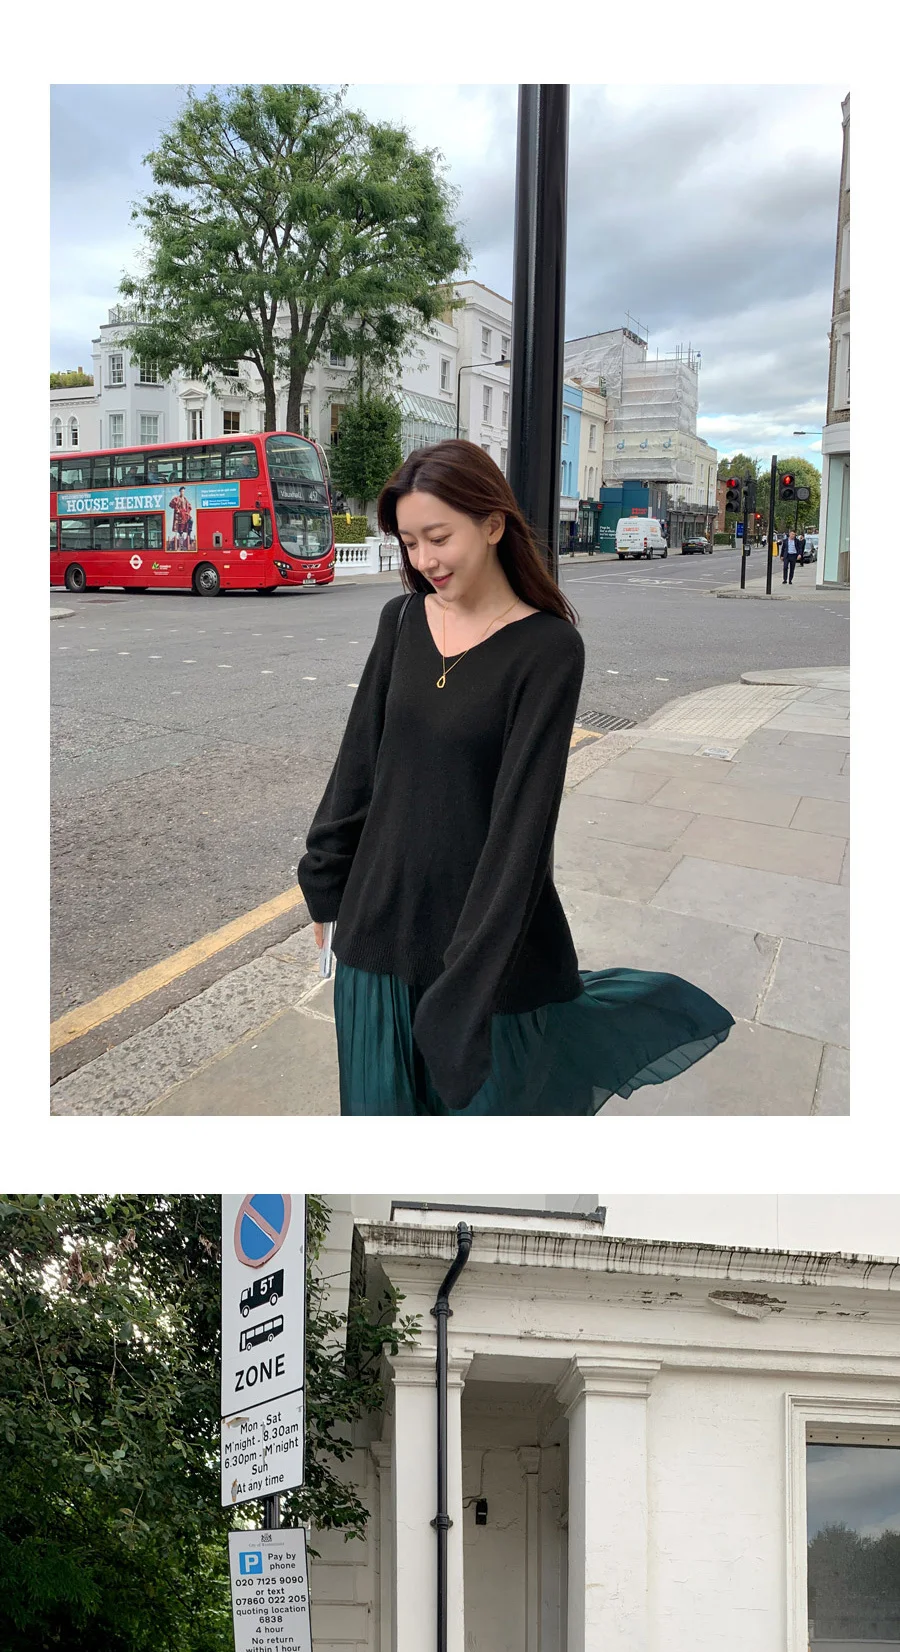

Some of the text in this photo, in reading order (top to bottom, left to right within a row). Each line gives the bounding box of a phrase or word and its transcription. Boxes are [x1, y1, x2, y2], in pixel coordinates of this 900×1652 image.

[66, 498, 108, 512] HOUSE
[114, 495, 162, 509] HENRY
[260, 1276, 274, 1295] 5T
[235, 1354, 285, 1392] ZONE
[240, 1422, 258, 1434] Mon
[266, 1412, 282, 1425] Sat
[225, 1436, 255, 1454] M'night
[264, 1423, 298, 1442] 8.30am
[225, 1452, 256, 1468] 6.30pm
[265, 1436, 298, 1456] M'night
[252, 1463, 268, 1475] Sun
[237, 1474, 284, 1494] At any time
[245, 1552, 296, 1572] P Pay by
[280, 1576, 304, 1584] 9090
[236, 1595, 306, 1605] 07860 022 205
[268, 1587, 284, 1595] text
[236, 1608, 268, 1616] quoting
